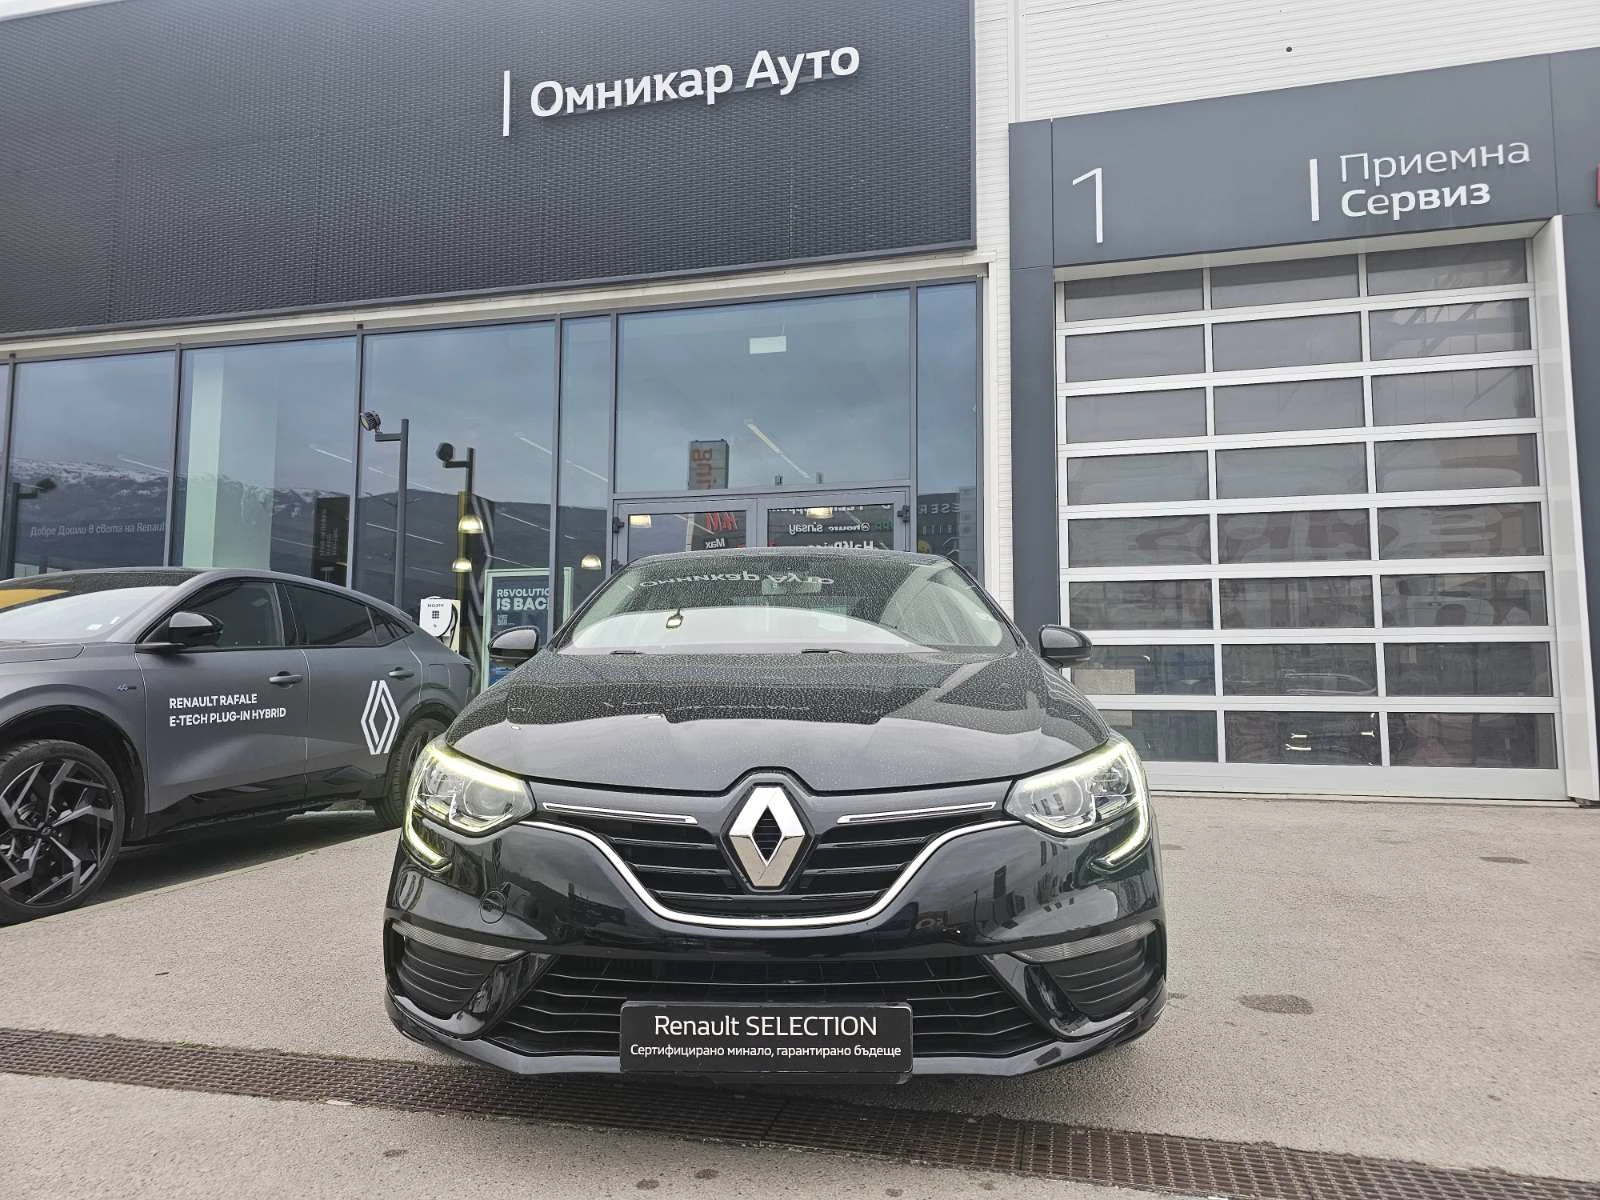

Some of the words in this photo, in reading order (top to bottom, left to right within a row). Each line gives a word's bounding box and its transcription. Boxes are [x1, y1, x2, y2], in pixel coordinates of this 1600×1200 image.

[530, 64, 733, 118] Омникар
[745, 46, 860, 96] Ауто
[1340, 141, 1530, 186] Приемна
[1072, 167, 1104, 244] 1
[1341, 182, 1491, 221] Сервиз
[496, 598, 511, 611] IS
[169, 697, 218, 709] RENAULT
[219, 693, 258, 706] RAFALE
[169, 713, 208, 727] E-TECH
[209, 710, 250, 724] PLUG-IN
[251, 707, 287, 719] HYBRID
[654, 1015, 739, 1036] Renault
[746, 1016, 877, 1036] SELECTION
[630, 1044, 725, 1058] Сертифицирано
[727, 1047, 774, 1058] минало,
[776, 1047, 852, 1057] гарантирано
[854, 1044, 902, 1057] бъдеще
